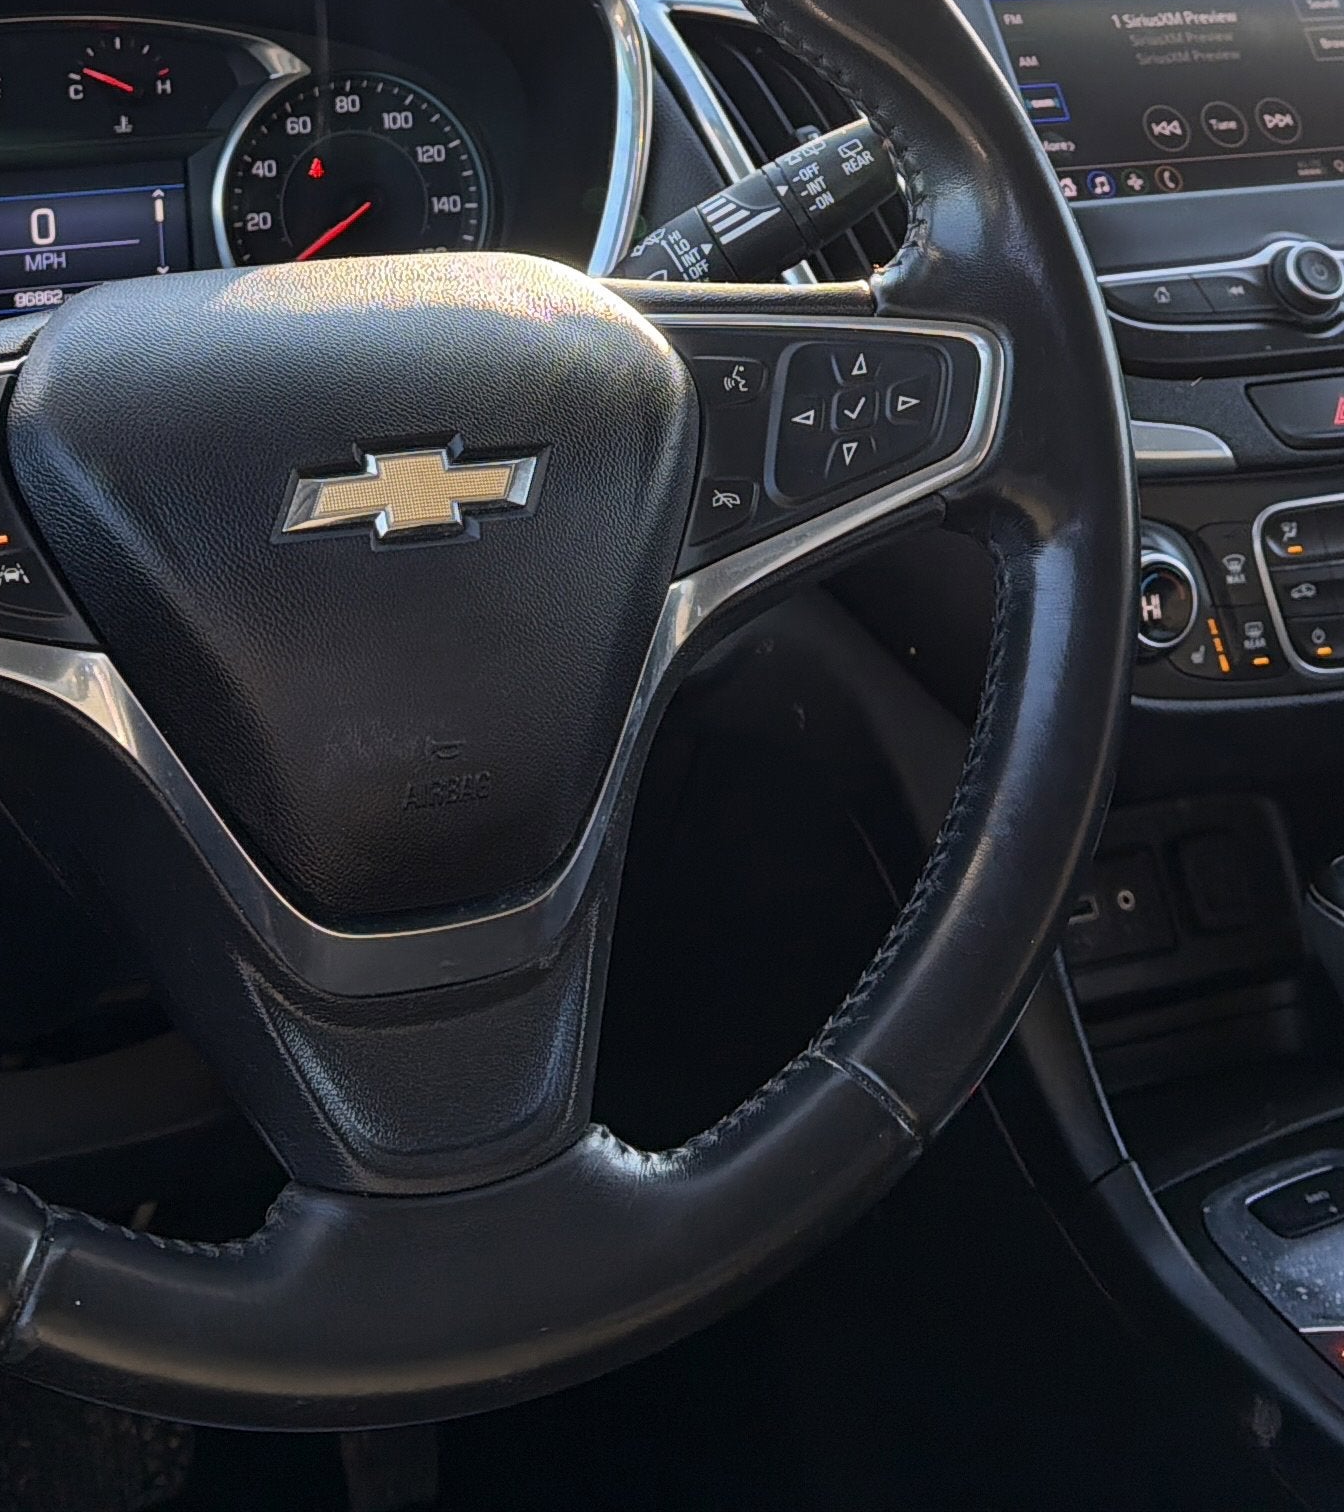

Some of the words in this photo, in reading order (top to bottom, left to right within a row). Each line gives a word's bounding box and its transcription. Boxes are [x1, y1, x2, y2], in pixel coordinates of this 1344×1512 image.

[1003, 12, 1024, 26] FM
[1111, 13, 1122, 30] 1
[1122, 11, 1184, 29] SiriusXM
[1183, 9, 1238, 25] Preview
[1129, 31, 1184, 47] SiriusXM
[1185, 30, 1234, 44] Preview
[1018, 55, 1040, 69] AM
[1136, 49, 1191, 66] SiriusXM
[1191, 48, 1241, 64] Preview
[68, 84, 84, 100] C
[156, 79, 172, 95] H
[335, 94, 360, 113] 80
[286, 116, 312, 135] 60
[382, 111, 413, 130] 100
[416, 144, 446, 163] 120
[841, 150, 875, 176] REAR
[251, 159, 277, 178] 40
[431, 195, 461, 213] 140
[30, 207, 57, 245] 0
[246, 212, 272, 232] 20
[668, 229, 683, 245] HI
[674, 238, 691, 256] LO
[25, 252, 67, 273] MPH
[680, 247, 701, 268] INT
[14, 289, 63, 308] 96862
[1243, 636, 1267, 650] REAR
